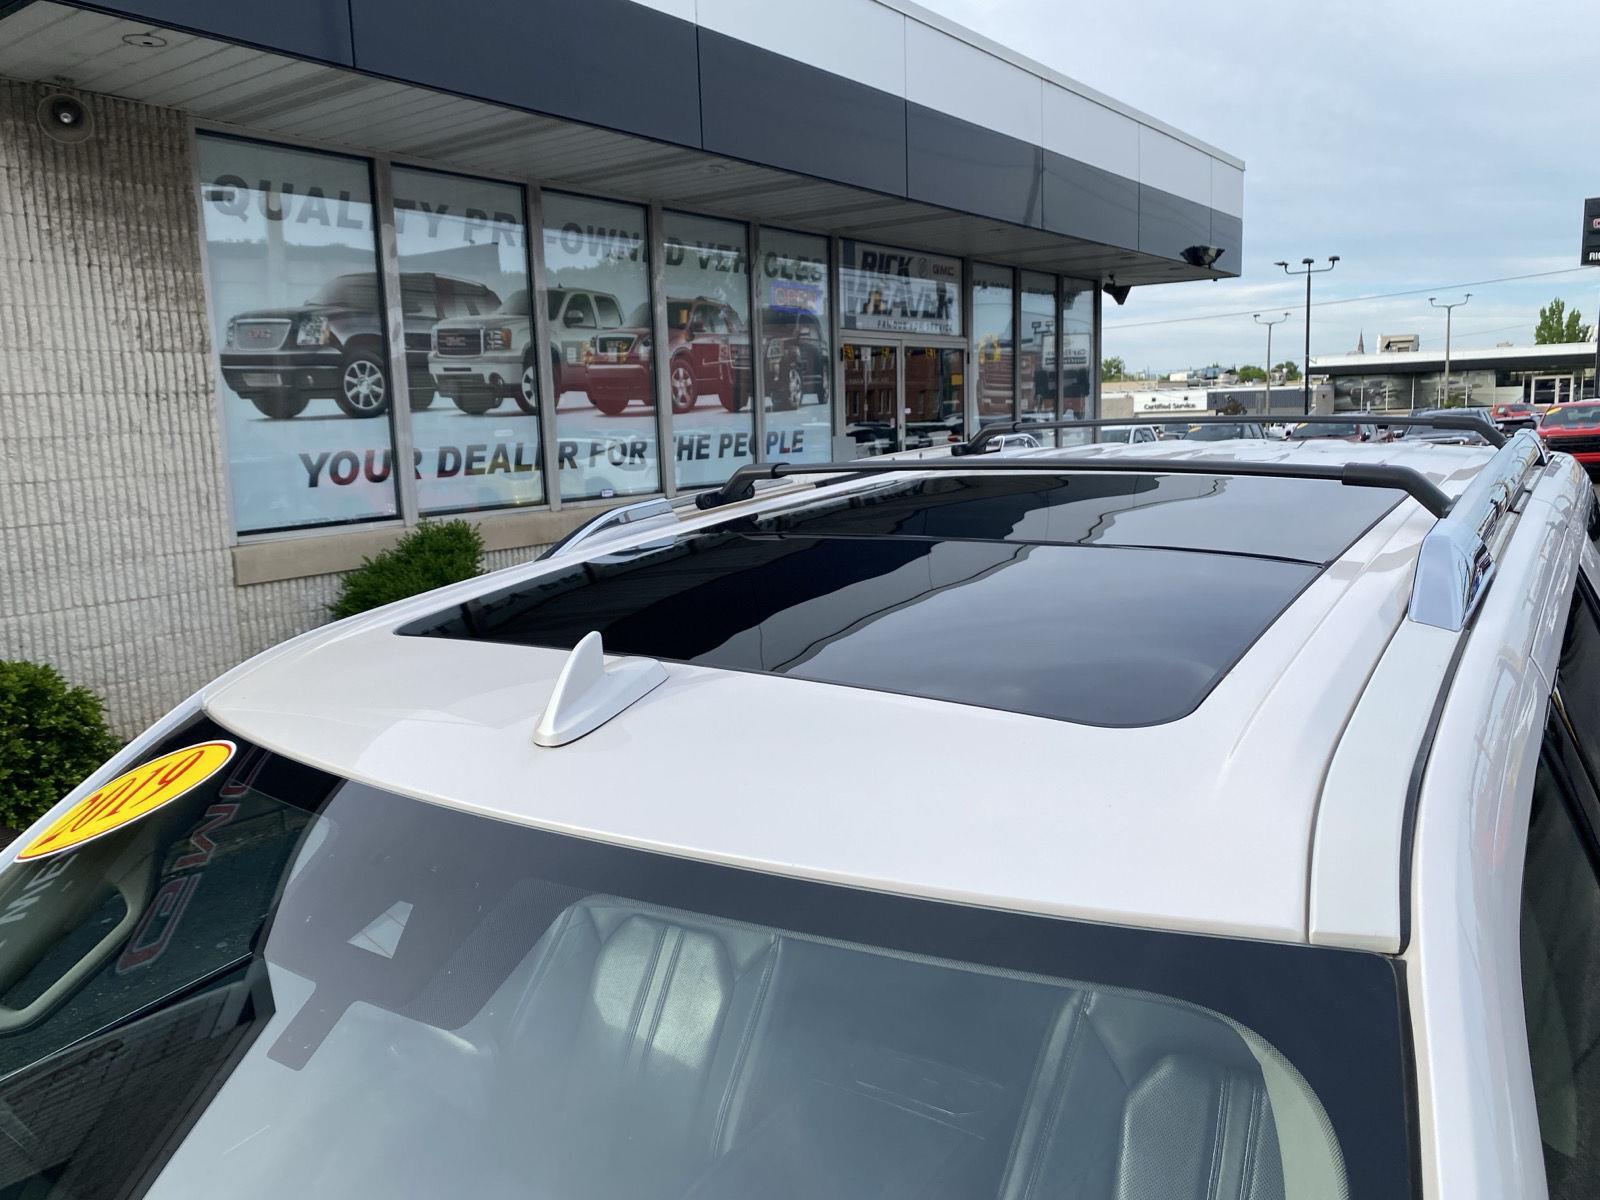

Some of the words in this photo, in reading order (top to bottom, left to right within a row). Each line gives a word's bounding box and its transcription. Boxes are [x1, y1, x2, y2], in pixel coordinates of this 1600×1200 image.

[463, 207, 685, 266] PR-OWND
[696, 240, 823, 282] VEHCLES
[861, 250, 914, 277] RICK
[1144, 402, 1171, 410] Certified
[1172, 401, 1196, 409] Service
[436, 440, 579, 478] DEALR
[588, 439, 648, 468] FOR
[673, 433, 711, 461] HE
